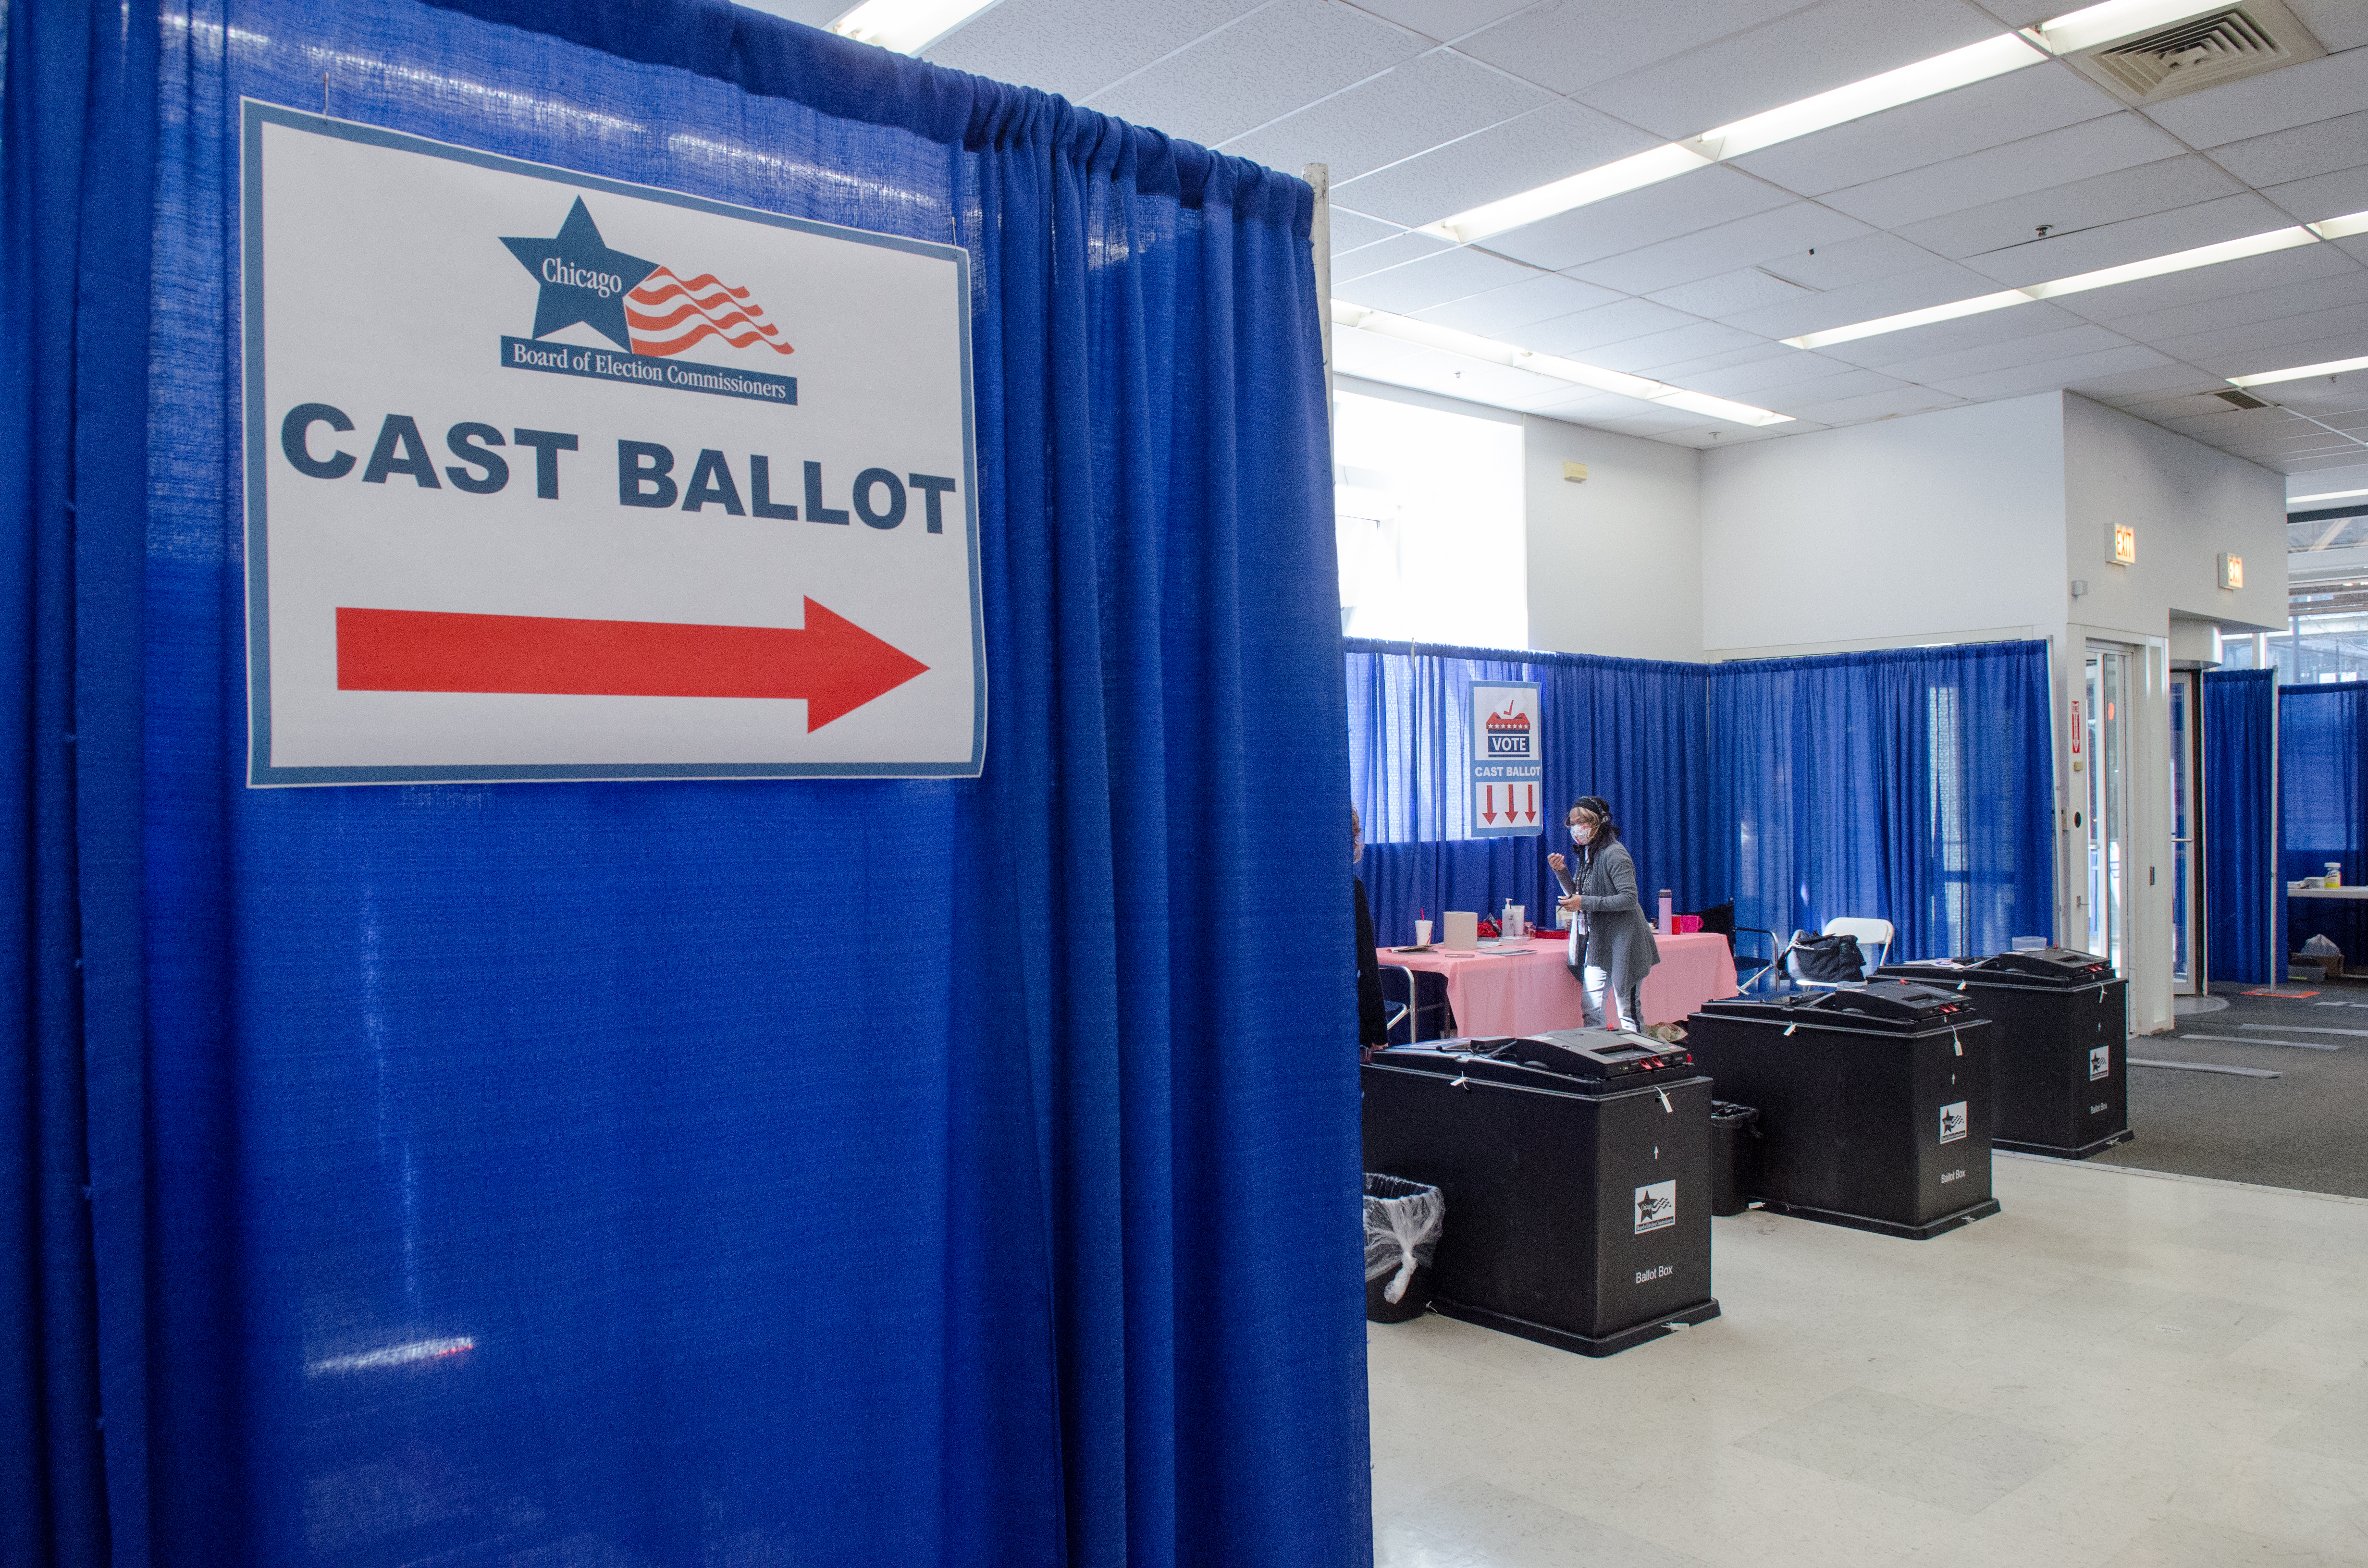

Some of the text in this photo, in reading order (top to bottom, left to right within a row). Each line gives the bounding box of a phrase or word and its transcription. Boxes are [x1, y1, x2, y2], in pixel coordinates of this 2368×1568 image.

[542, 257, 622, 298] Chicago
[513, 343, 786, 398] Board of Election Commissioners
[281, 402, 957, 535] CAST BALLOT
[2117, 530, 2131, 557] EXIT
[2229, 559, 2240, 583] EXIT
[1492, 737, 1526, 751] VOTE
[1475, 766, 1541, 777] CAST BALLOT
[1941, 1169, 1966, 1183] Ballot Box
[1636, 1265, 1673, 1284] Ballot Box
